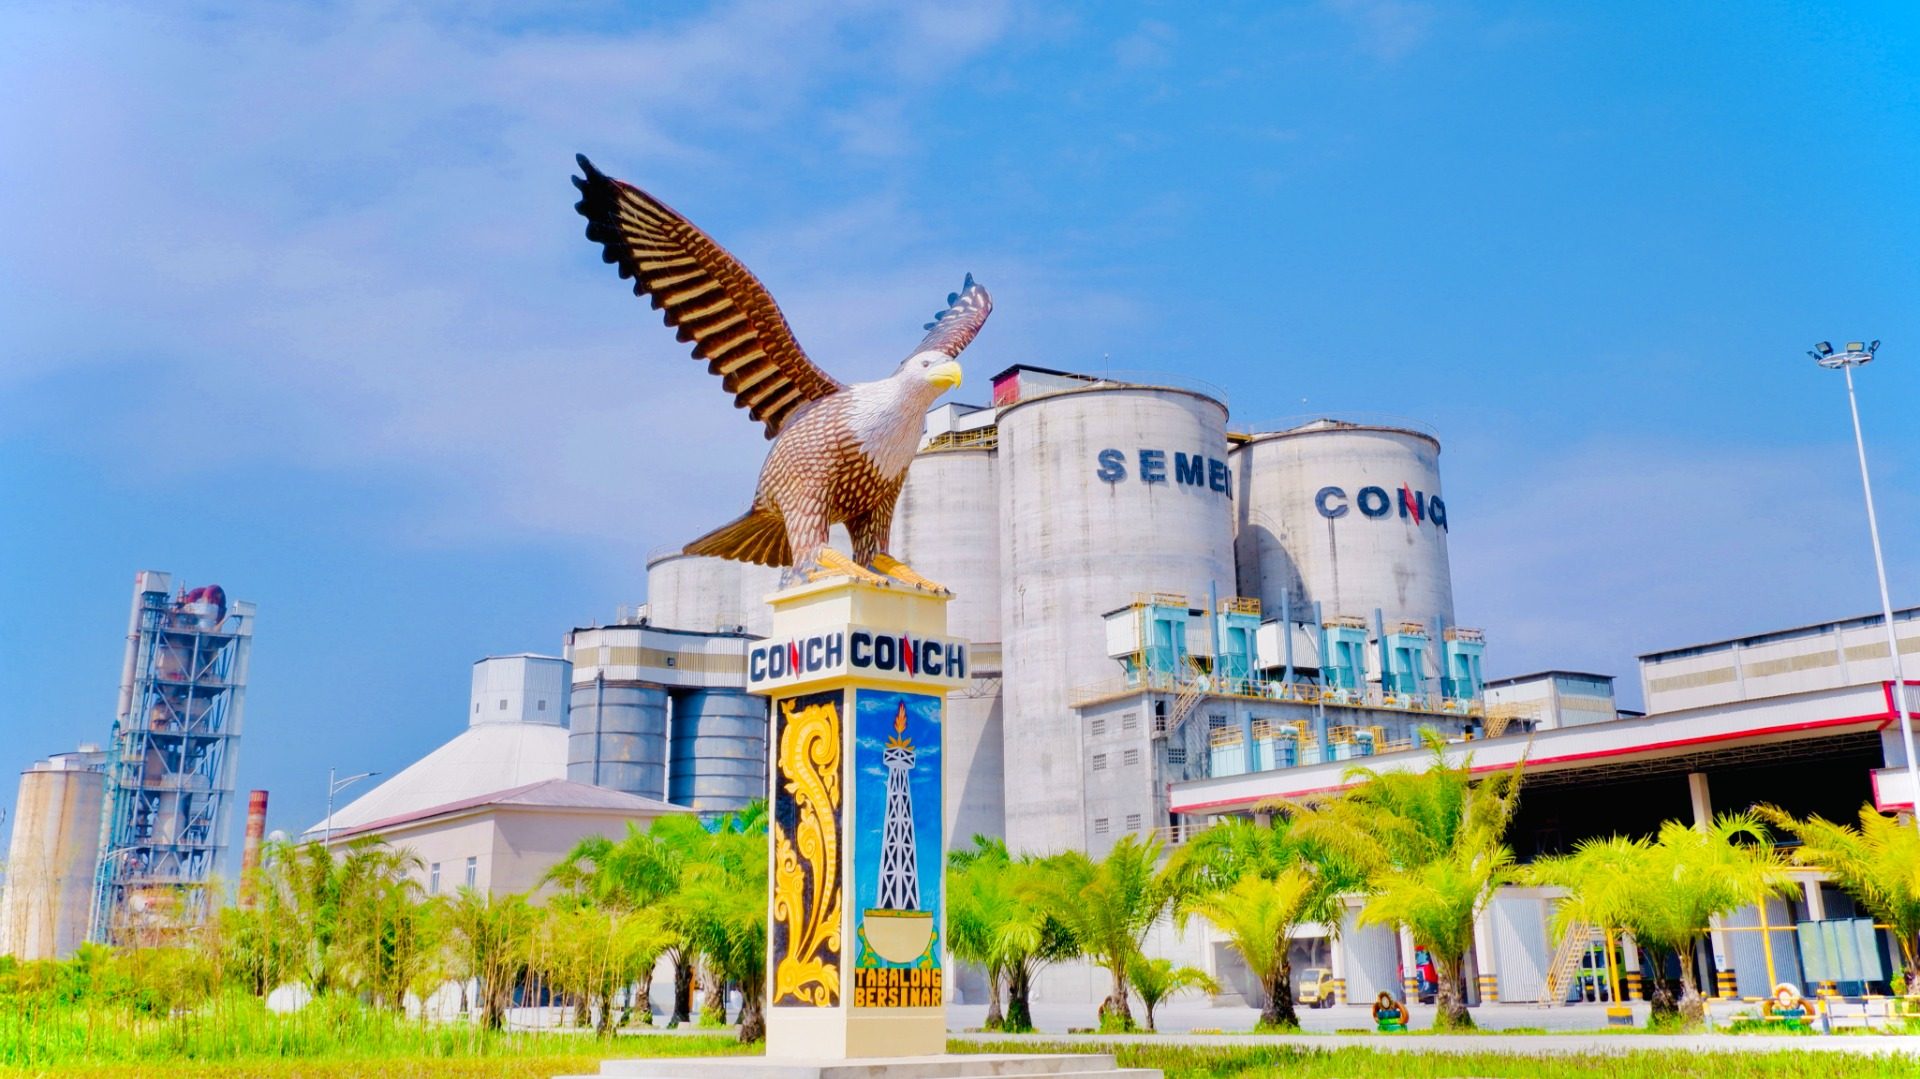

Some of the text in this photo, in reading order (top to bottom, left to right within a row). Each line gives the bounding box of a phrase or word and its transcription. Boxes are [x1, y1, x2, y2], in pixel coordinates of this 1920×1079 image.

[750, 632, 843, 683] CONCH
[850, 631, 965, 679] CONCH
[855, 968, 941, 987] TABALONG
[855, 988, 941, 1007] BERSINAR
